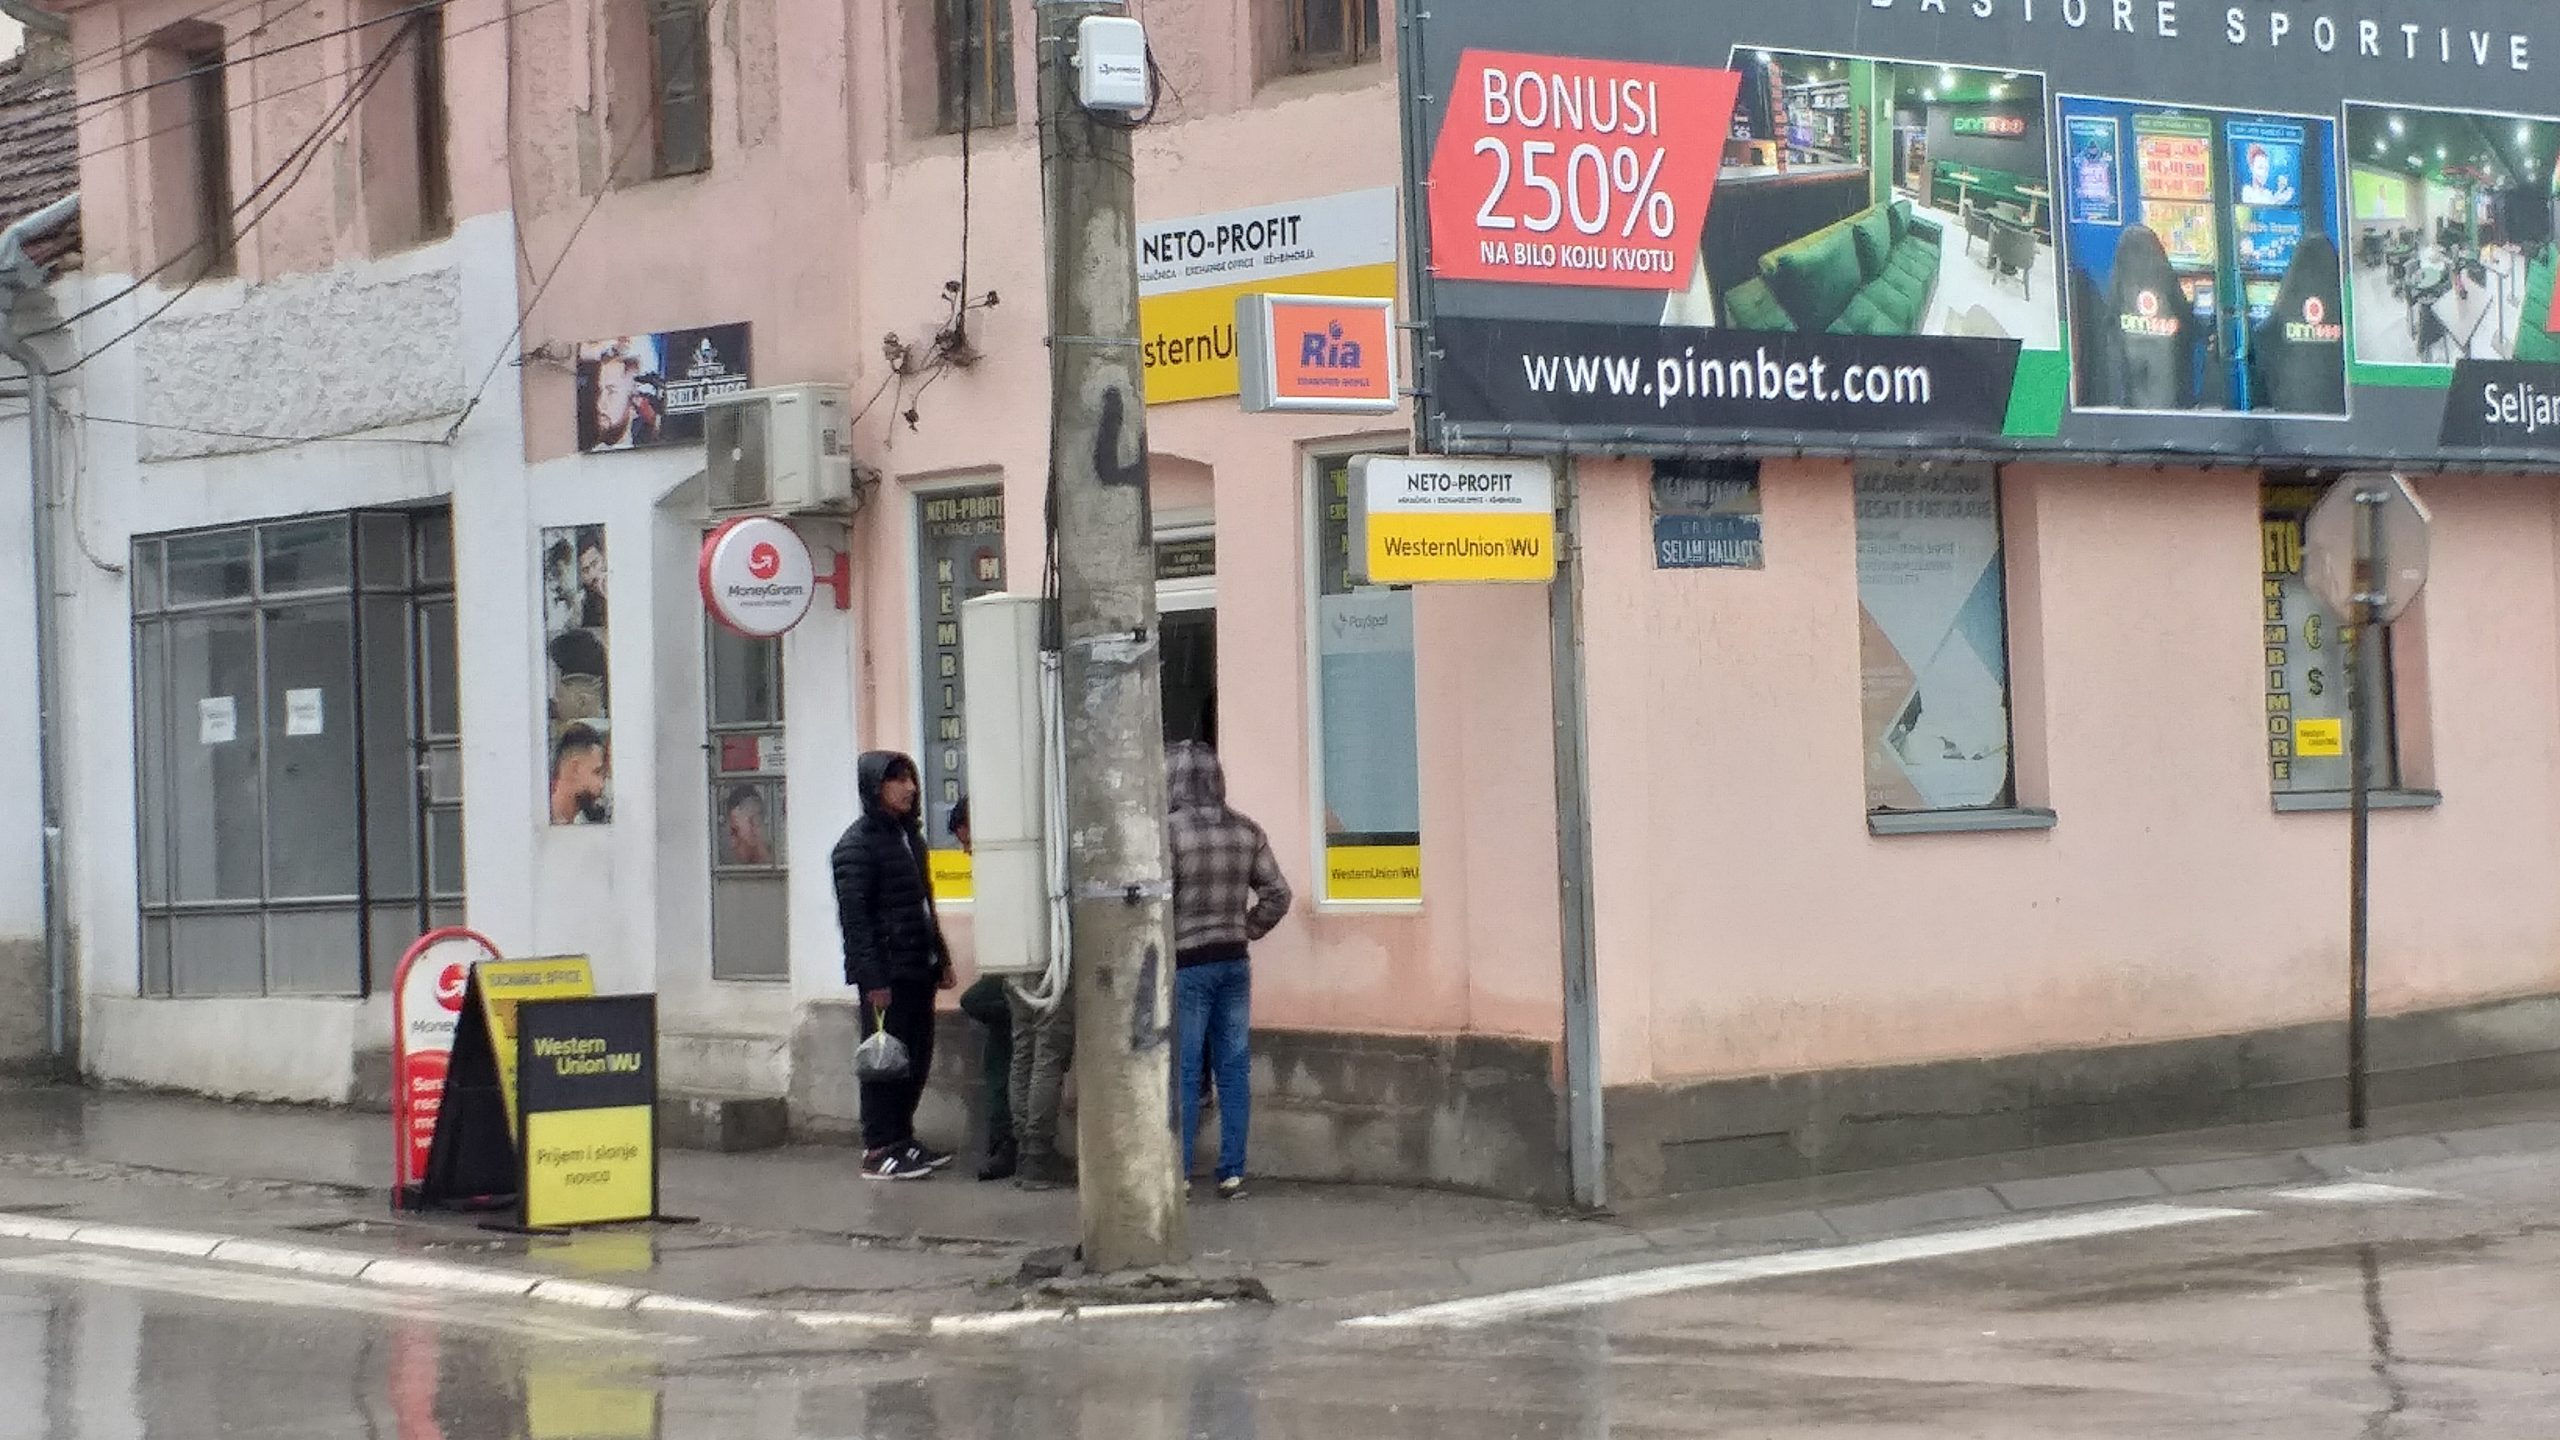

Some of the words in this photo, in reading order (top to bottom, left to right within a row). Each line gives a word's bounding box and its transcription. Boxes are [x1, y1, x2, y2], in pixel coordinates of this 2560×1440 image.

[2226, 7, 2530, 70] SPORTIVE
[1482, 67, 1659, 136] BONUSI
[1473, 137, 1675, 239] 250%
[1143, 214, 1302, 265] NETO-PROFIT
[1480, 240, 1508, 264] NA
[1514, 242, 1557, 267] BILO
[1560, 244, 1607, 270] KOJU
[1612, 247, 1674, 273] KVOTU
[1300, 320, 1362, 369] Ria
[1522, 347, 1931, 408] www.pinnbet.com
[1407, 473, 1513, 492] NETO-PROFIT
[1384, 535, 1505, 557] WesternUnion
[1510, 537, 1540, 557] WU
[728, 584, 803, 599] MoneyGram
[411, 1019, 457, 1034] Money
[533, 1037, 607, 1057] Western
[556, 1053, 607, 1075] Union
[611, 1052, 642, 1073] WU
[536, 1147, 585, 1169] Prijem
[595, 1144, 639, 1162] slanje
[565, 1169, 611, 1187] novca
